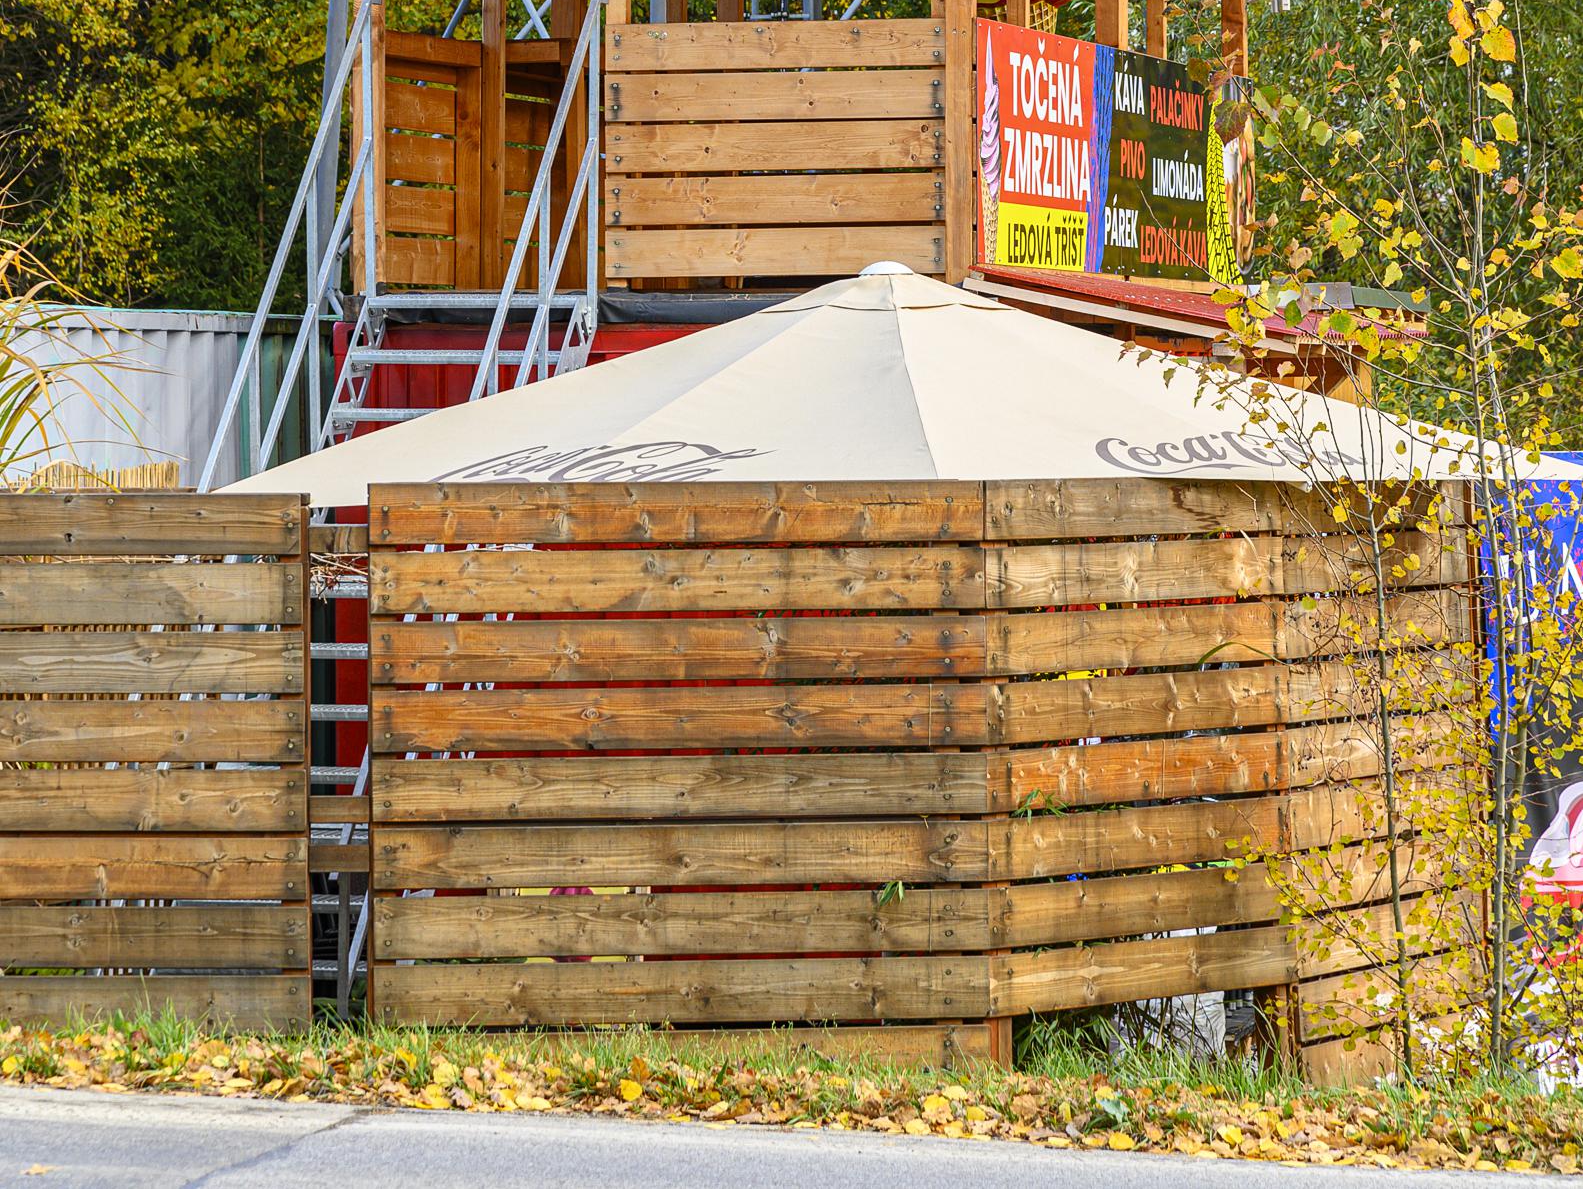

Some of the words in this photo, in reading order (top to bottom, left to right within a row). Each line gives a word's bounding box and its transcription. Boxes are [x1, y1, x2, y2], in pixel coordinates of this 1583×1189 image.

[1009, 37, 1083, 127] TOČENÁ
[1114, 60, 1145, 115] KÁVA
[1150, 79, 1204, 132] PALAČINKY
[1004, 127, 1091, 202] ZMRZLINA
[1120, 138, 1146, 180] PIVO
[1152, 149, 1204, 202] LIMONÁDA
[1008, 212, 1052, 265] LEDOVÁ
[1055, 213, 1084, 267] TŘÍŠŤ
[1104, 193, 1139, 248] PÁREK
[1140, 215, 1178, 266] LEDOVÁ
[1180, 217, 1208, 268] KÁVA
